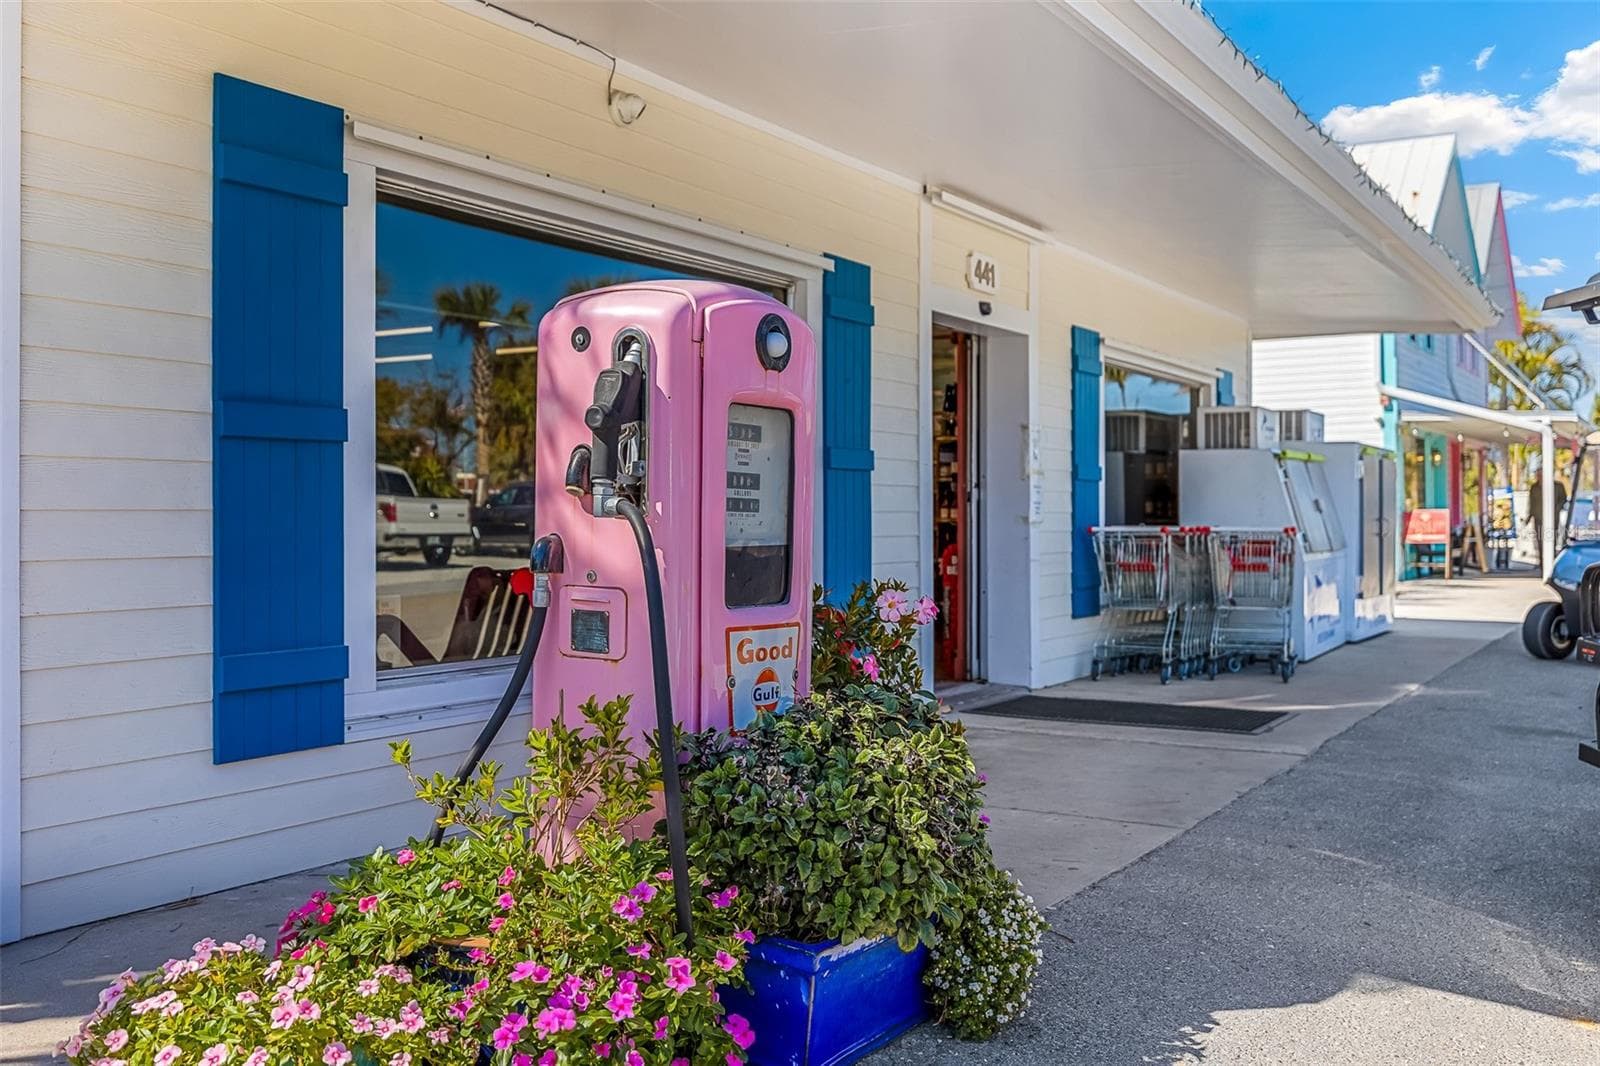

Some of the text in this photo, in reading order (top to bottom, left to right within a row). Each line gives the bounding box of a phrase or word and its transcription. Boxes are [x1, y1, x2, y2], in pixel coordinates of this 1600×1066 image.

[974, 259, 995, 288] 441
[736, 637, 793, 665] Good
[753, 686, 780, 702] Gulf
